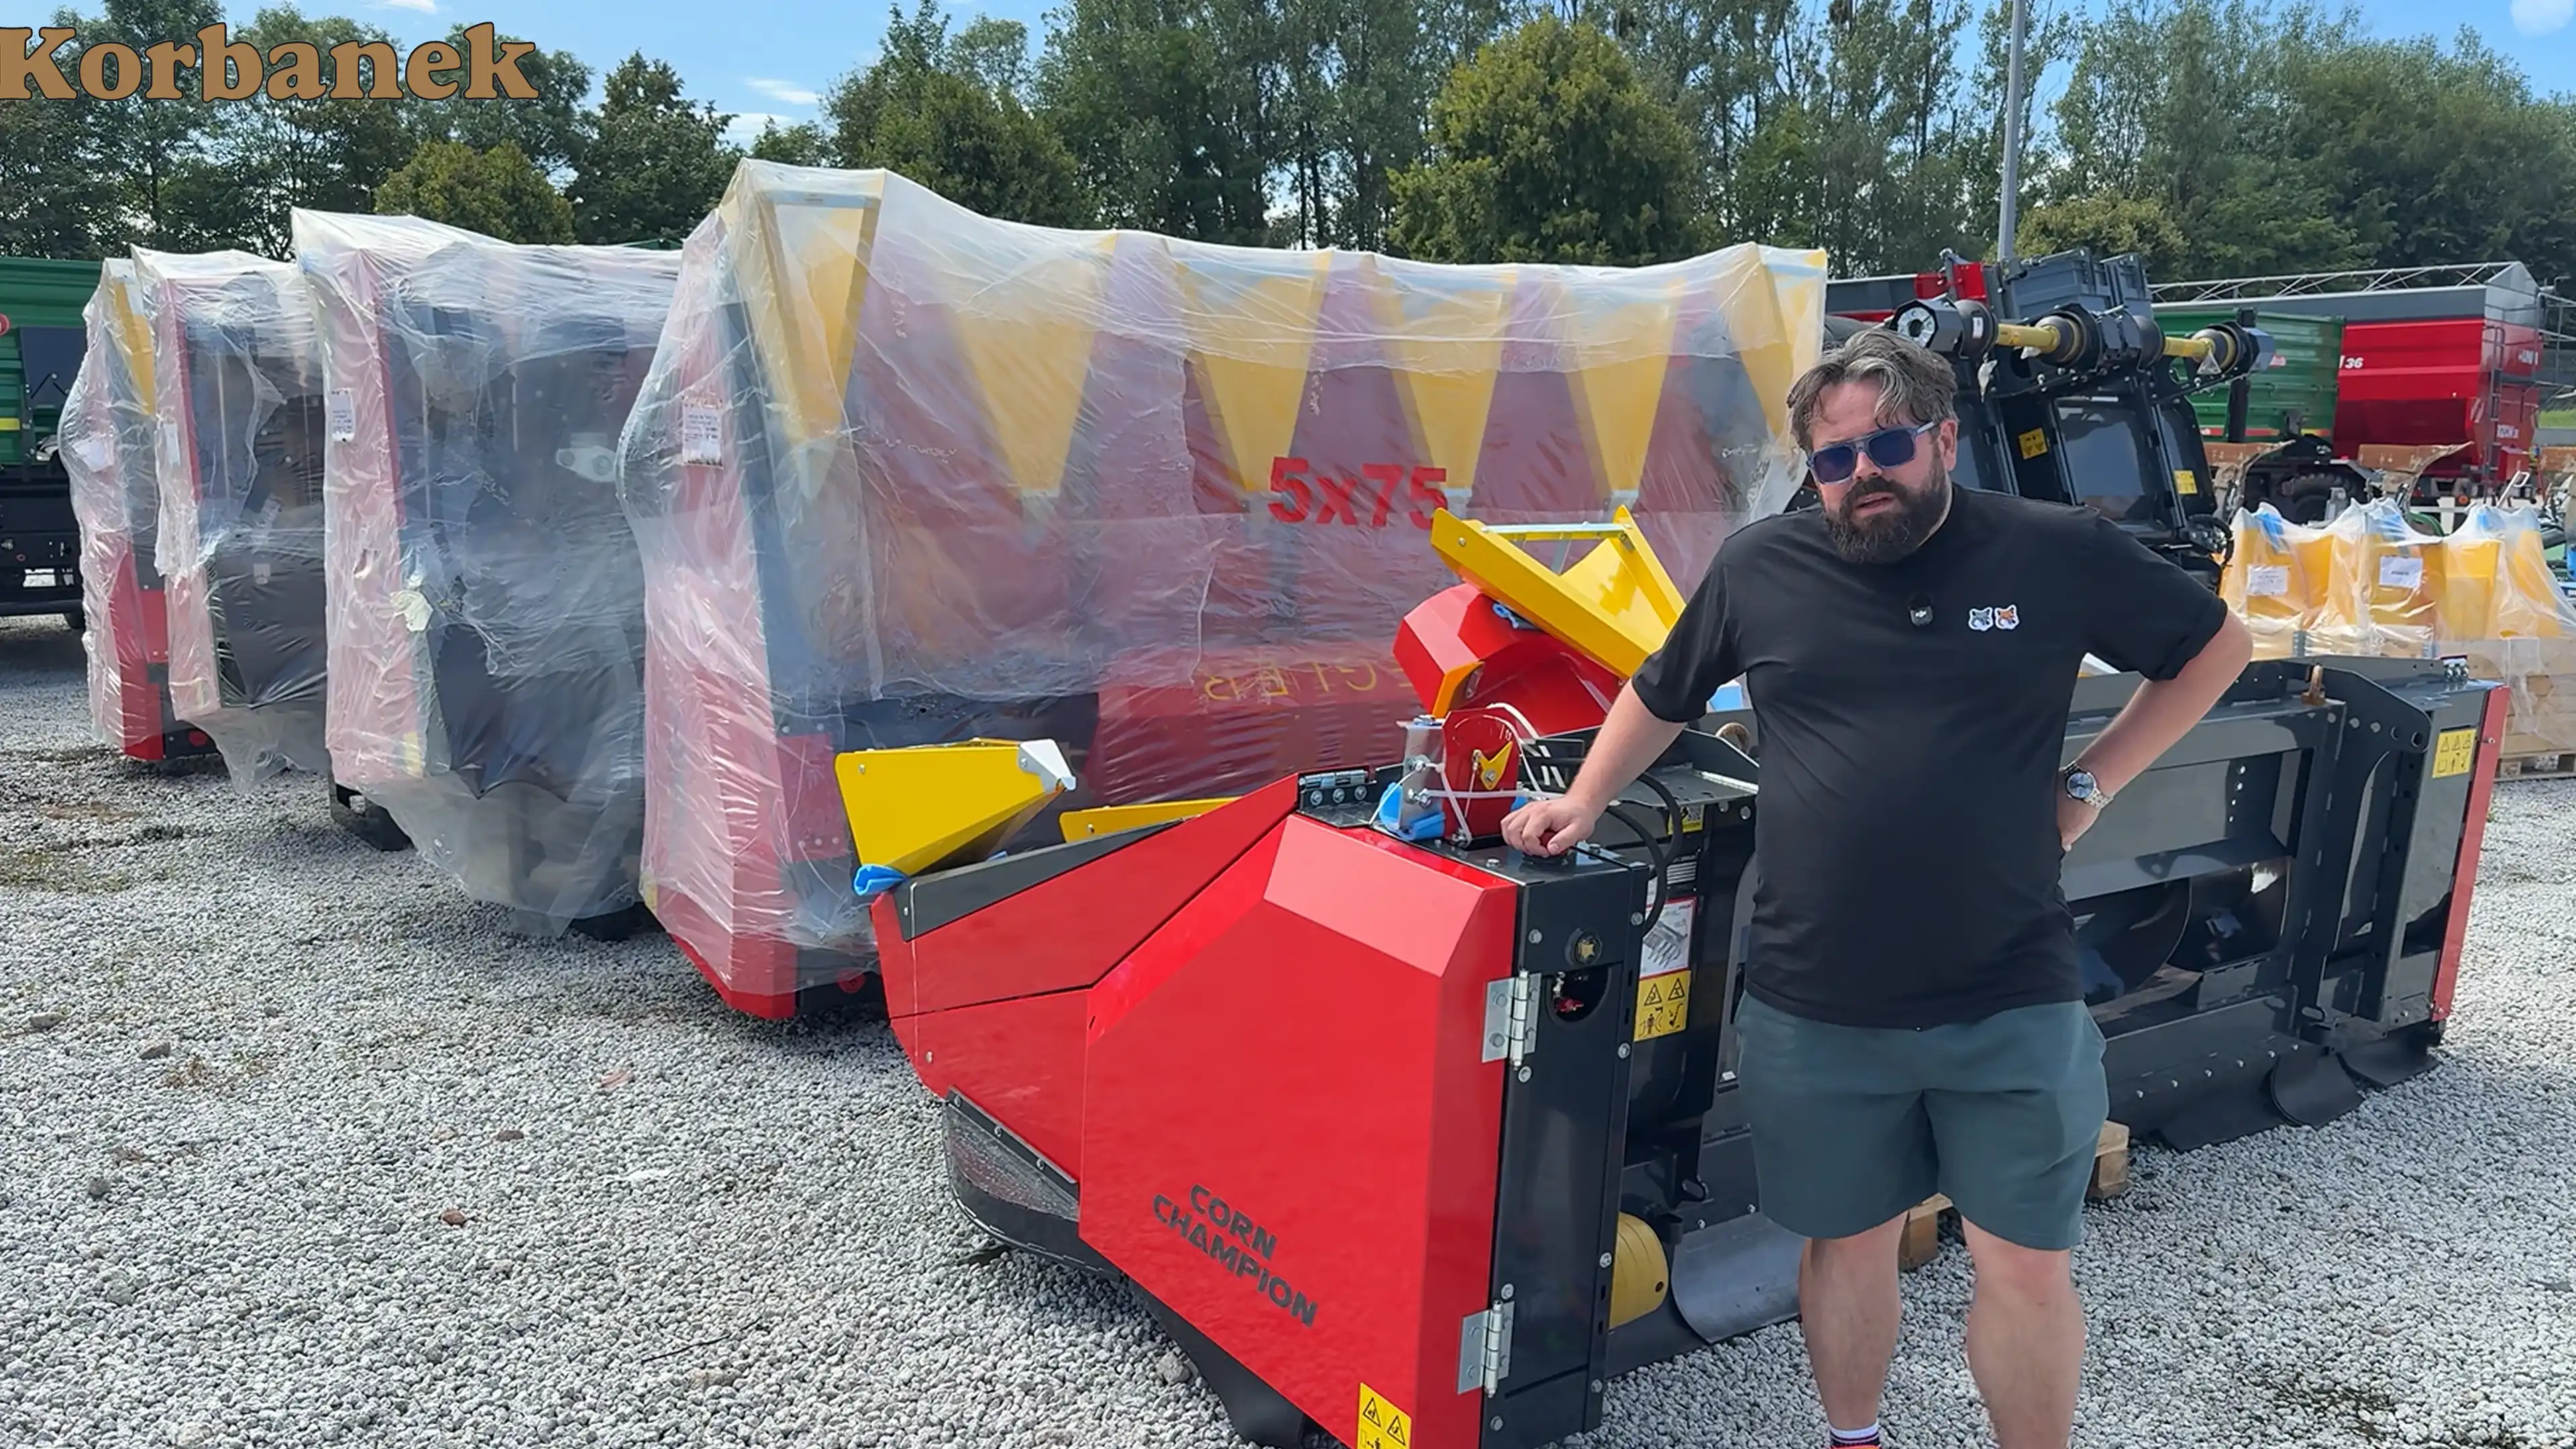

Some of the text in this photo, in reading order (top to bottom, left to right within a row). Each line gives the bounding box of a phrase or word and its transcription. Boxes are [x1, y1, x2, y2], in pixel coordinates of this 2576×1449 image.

[2345, 357, 2364, 369] 36
[1267, 456, 1448, 531] 5x75
[1189, 1183, 1278, 1261] CORN
